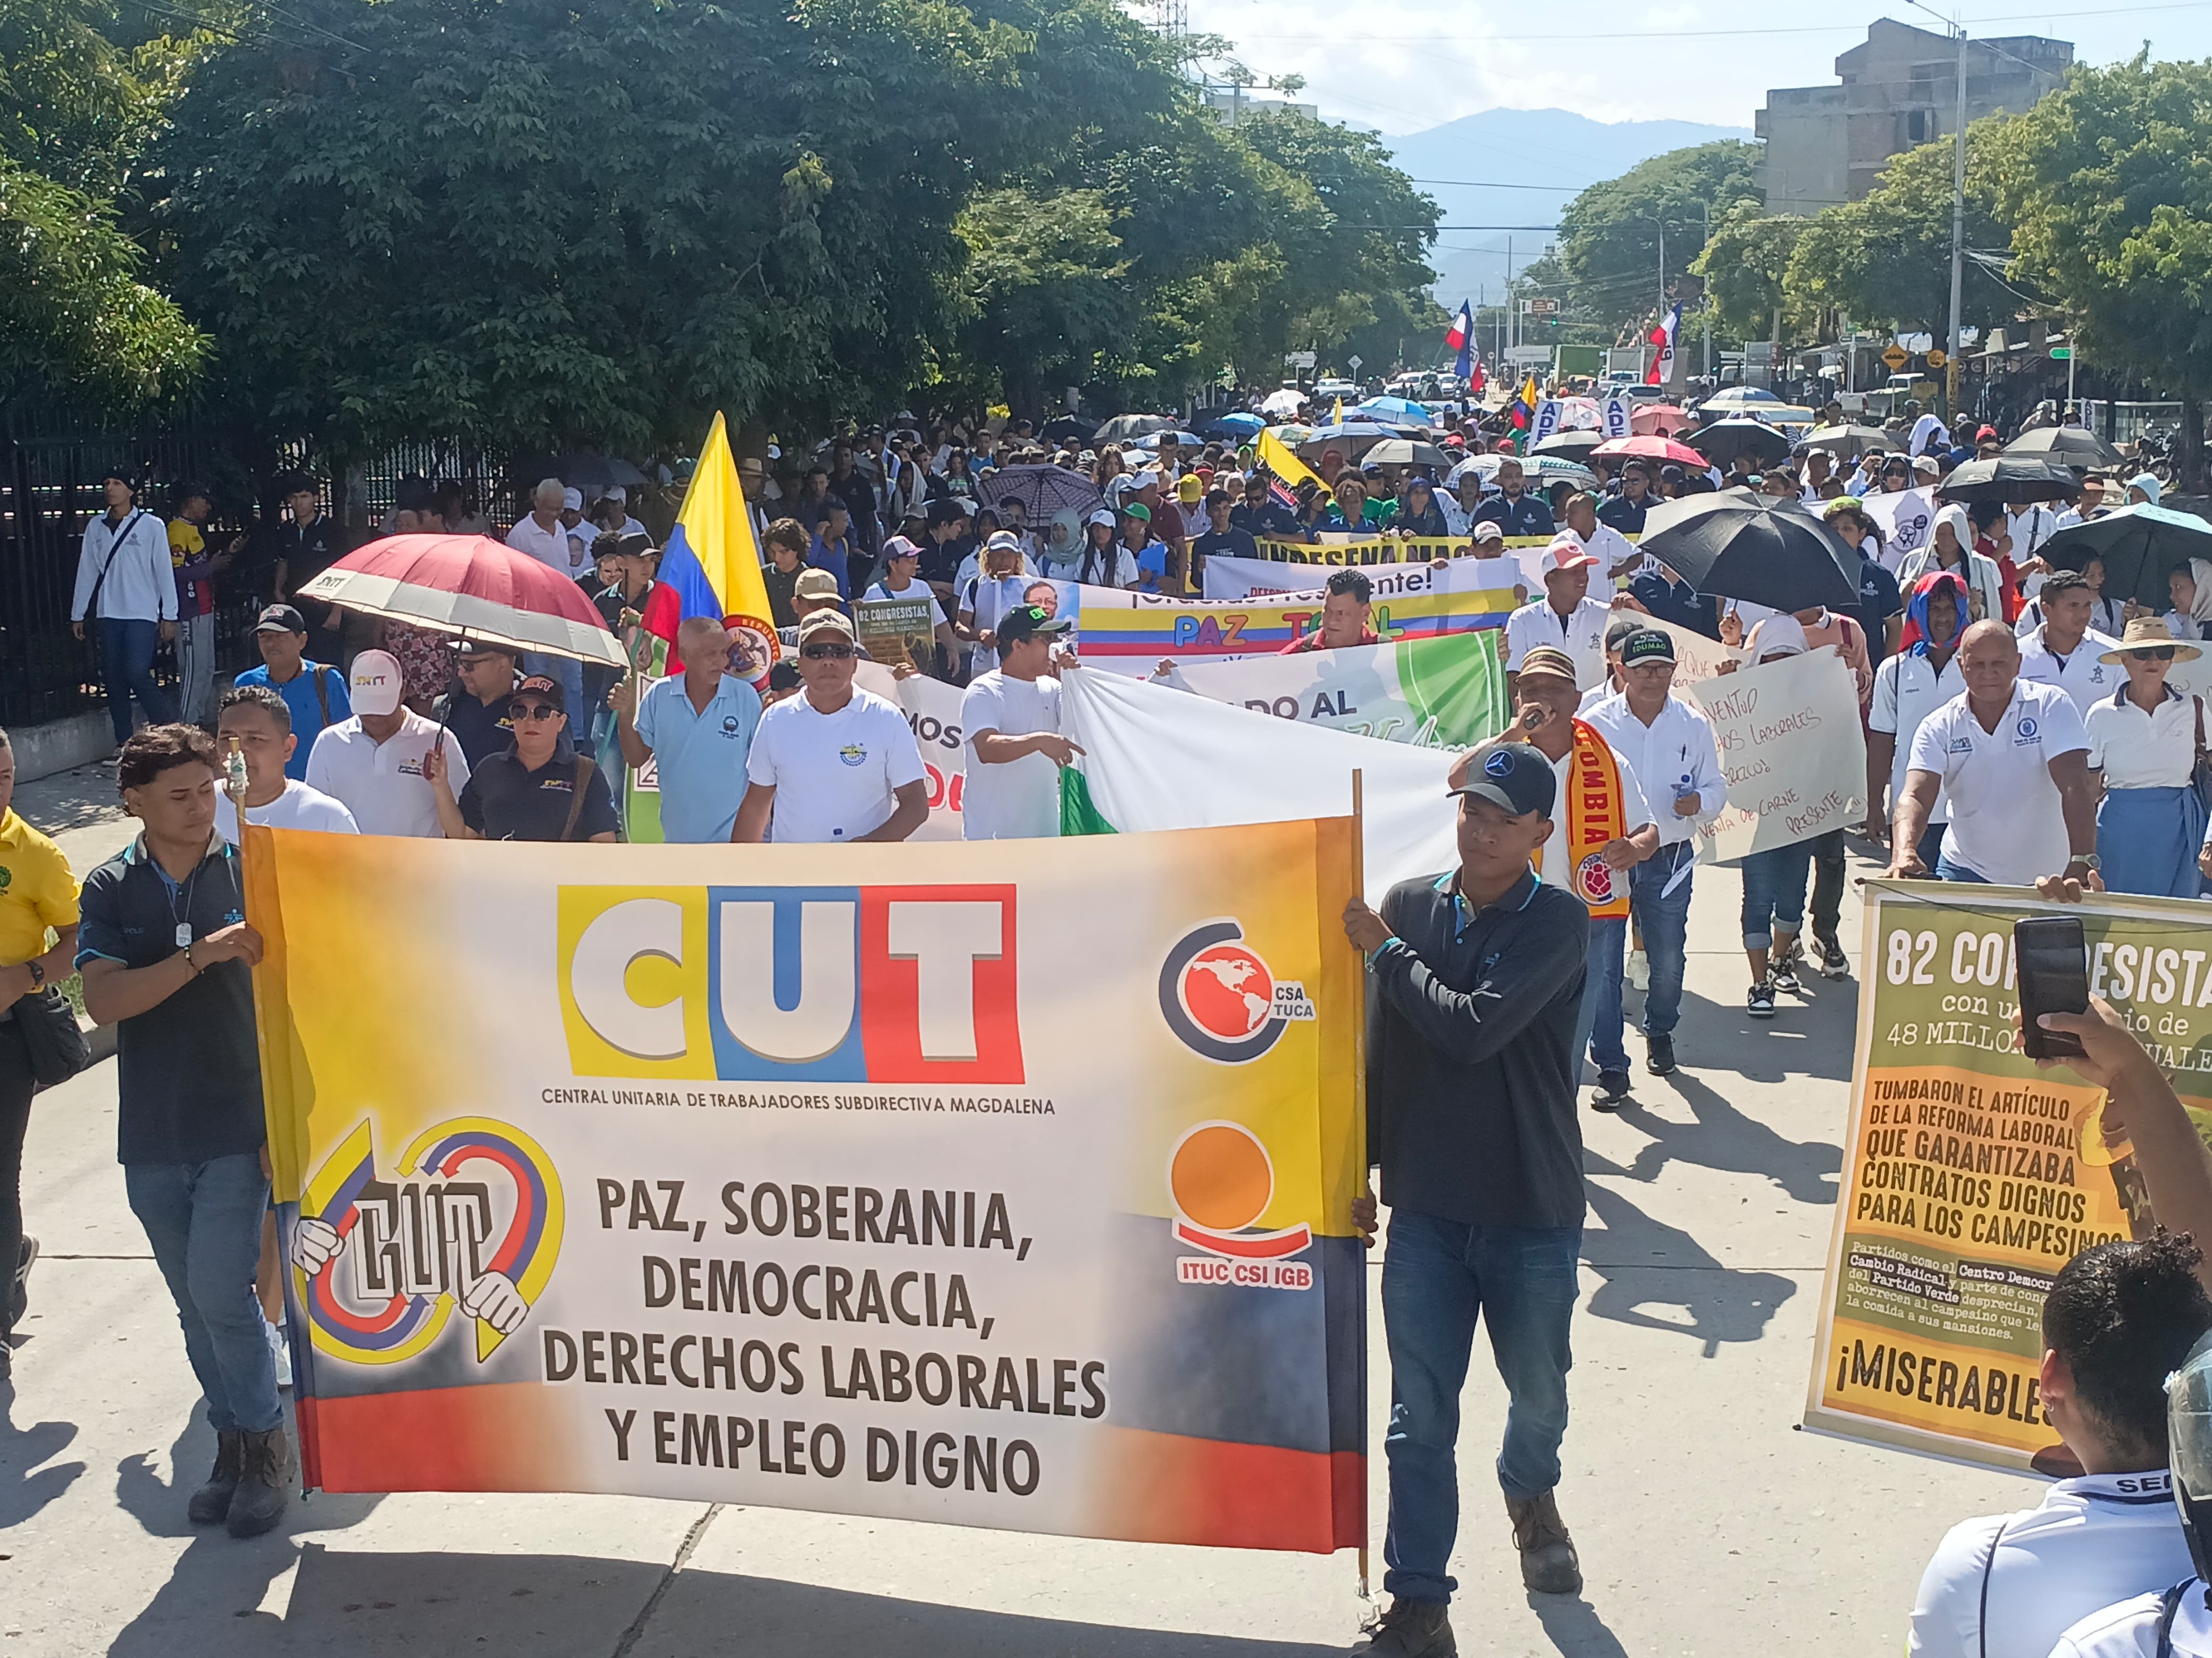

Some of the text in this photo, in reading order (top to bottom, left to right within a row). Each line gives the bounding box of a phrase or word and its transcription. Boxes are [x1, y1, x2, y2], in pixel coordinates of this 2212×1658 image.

[1174, 615, 1249, 647] PAZ
[1311, 690, 1357, 719] AL
[1698, 787, 1800, 839] VENTA DE CARNE
[1785, 789, 1844, 836] PRESENTE
[571, 897, 1003, 1064] CUT
[1887, 929, 1938, 986] 82
[1273, 1003, 1314, 1018] TUCA
[1275, 986, 1304, 1002] CSA
[1941, 995, 1989, 1015] con
[2158, 1011, 2189, 1036] de
[1887, 1023, 1918, 1047] 48
[1925, 1021, 2025, 1055] MILLO
[541, 1089, 1055, 1115] CENTRAL UNITARIA DE TRABAJADORES SUBDIRECTIVA MAGDALENA
[1874, 1079, 2070, 1122] TUMBARON EL ARTÍCULO
[1870, 1104, 2075, 1151] DE LA REFORMA LABORAL
[1866, 1128, 2075, 1188] QUE GARANTIZABA
[1861, 1160, 2087, 1224] CONTRATOS DIGNOS
[596, 1177, 1033, 1261] PAZ, SOBERANIA,
[1857, 1192, 2123, 1259] PARA LOS CAMPESIN
[1182, 1262, 1310, 1287] ITUC CSI IGB
[1850, 1255, 1895, 1273] Cambio
[1948, 1279, 1957, 1290] y
[1959, 1281, 1998, 1294] parte
[2000, 1285, 2015, 1297] de
[1851, 1241, 2054, 1291] Partidos como el Centro Democr
[642, 1255, 995, 1340] DEMOCRACIA,
[1847, 1282, 1911, 1306] aborrecen
[1914, 1298, 1929, 1310] al
[1931, 1303, 1998, 1322] campesino
[2000, 1314, 2022, 1327] que
[1849, 1268, 2039, 1318] del Partido Verde desprecian,
[1846, 1294, 2014, 1341] la comida a sus mansiones.
[543, 1329, 1107, 1419] DERECHOS LABORALES
[1836, 1338, 2054, 1427] ¡MISERABLE
[604, 1408, 1040, 1496] Y EMPLEO DIGNO
